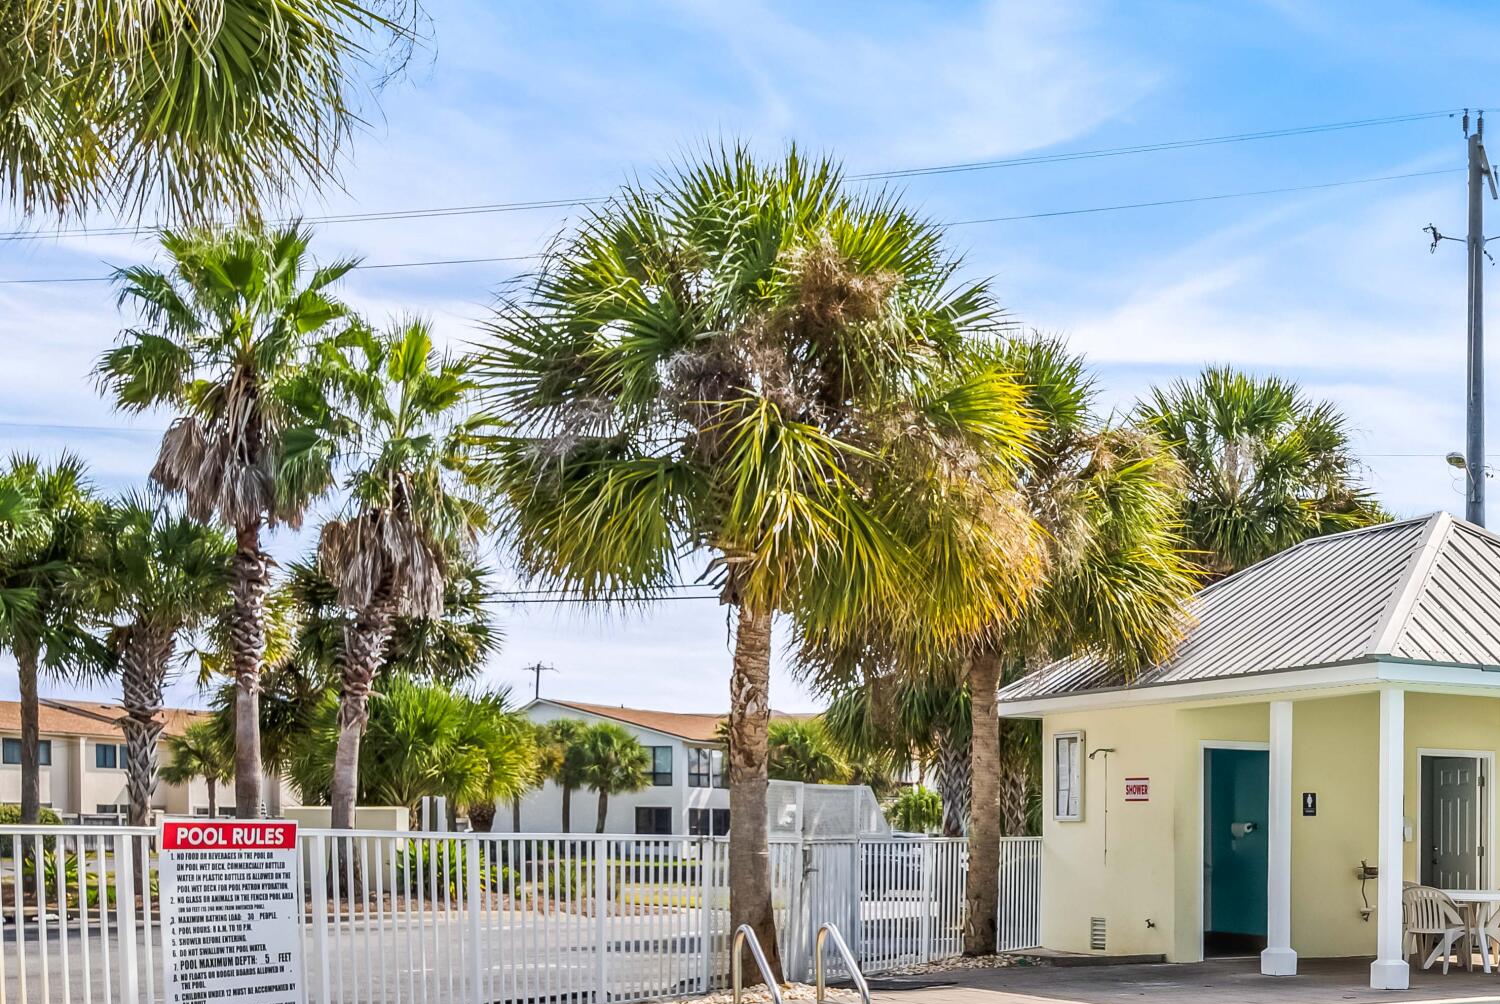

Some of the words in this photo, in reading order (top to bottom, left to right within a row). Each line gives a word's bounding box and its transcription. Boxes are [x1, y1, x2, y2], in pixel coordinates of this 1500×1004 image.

[1126, 785, 1148, 795] SHOWER
[176, 827, 227, 846] POOL
[232, 828, 284, 845] RULES
[177, 852, 184, 860] NO
[185, 852, 199, 860] FOOD
[267, 851, 273, 859] OR
[177, 863, 184, 871] ON
[185, 863, 198, 871] POOL
[227, 862, 264, 870] COMMERCIALLY
[265, 861, 285, 869] BOTTLED
[177, 874, 194, 882] WATER
[252, 872, 274, 880] ALLOWED
[177, 885, 190, 893] POOL
[186, 895, 202, 903] GLASS
[282, 892, 293, 900] AREA
[178, 915, 204, 923] MAXIMUM
[206, 914, 227, 922] BATHING
[179, 926, 191, 935] POOL
[229, 924, 235, 932] TO
[179, 937, 201, 946] SHOWER
[203, 936, 221, 944] BEFORE
[199, 946, 225, 955] SWALLOW
[181, 959, 197, 970] POOL
[199, 956, 233, 968] MAXIMUM
[235, 955, 257, 966] DEPTH:
[278, 952, 291, 963] FEET
[181, 973, 188, 981] NO
[189, 971, 207, 980] FLOATS
[208, 971, 215, 979] OR
[217, 969, 234, 978] BOOGIE
[236, 967, 256, 976] BOARDS
[257, 965, 278, 975] ALLOWED
[280, 965, 284, 973] IN
[181, 982, 191, 990] THE
[182, 991, 207, 1001] CHILDREN
[208, 990, 225, 998] UNDER
[233, 987, 246, 996] MUST
[248, 986, 254, 994] BE
[255, 983, 288, 994] ACCOMPANIED
[289, 983, 295, 991] BY
